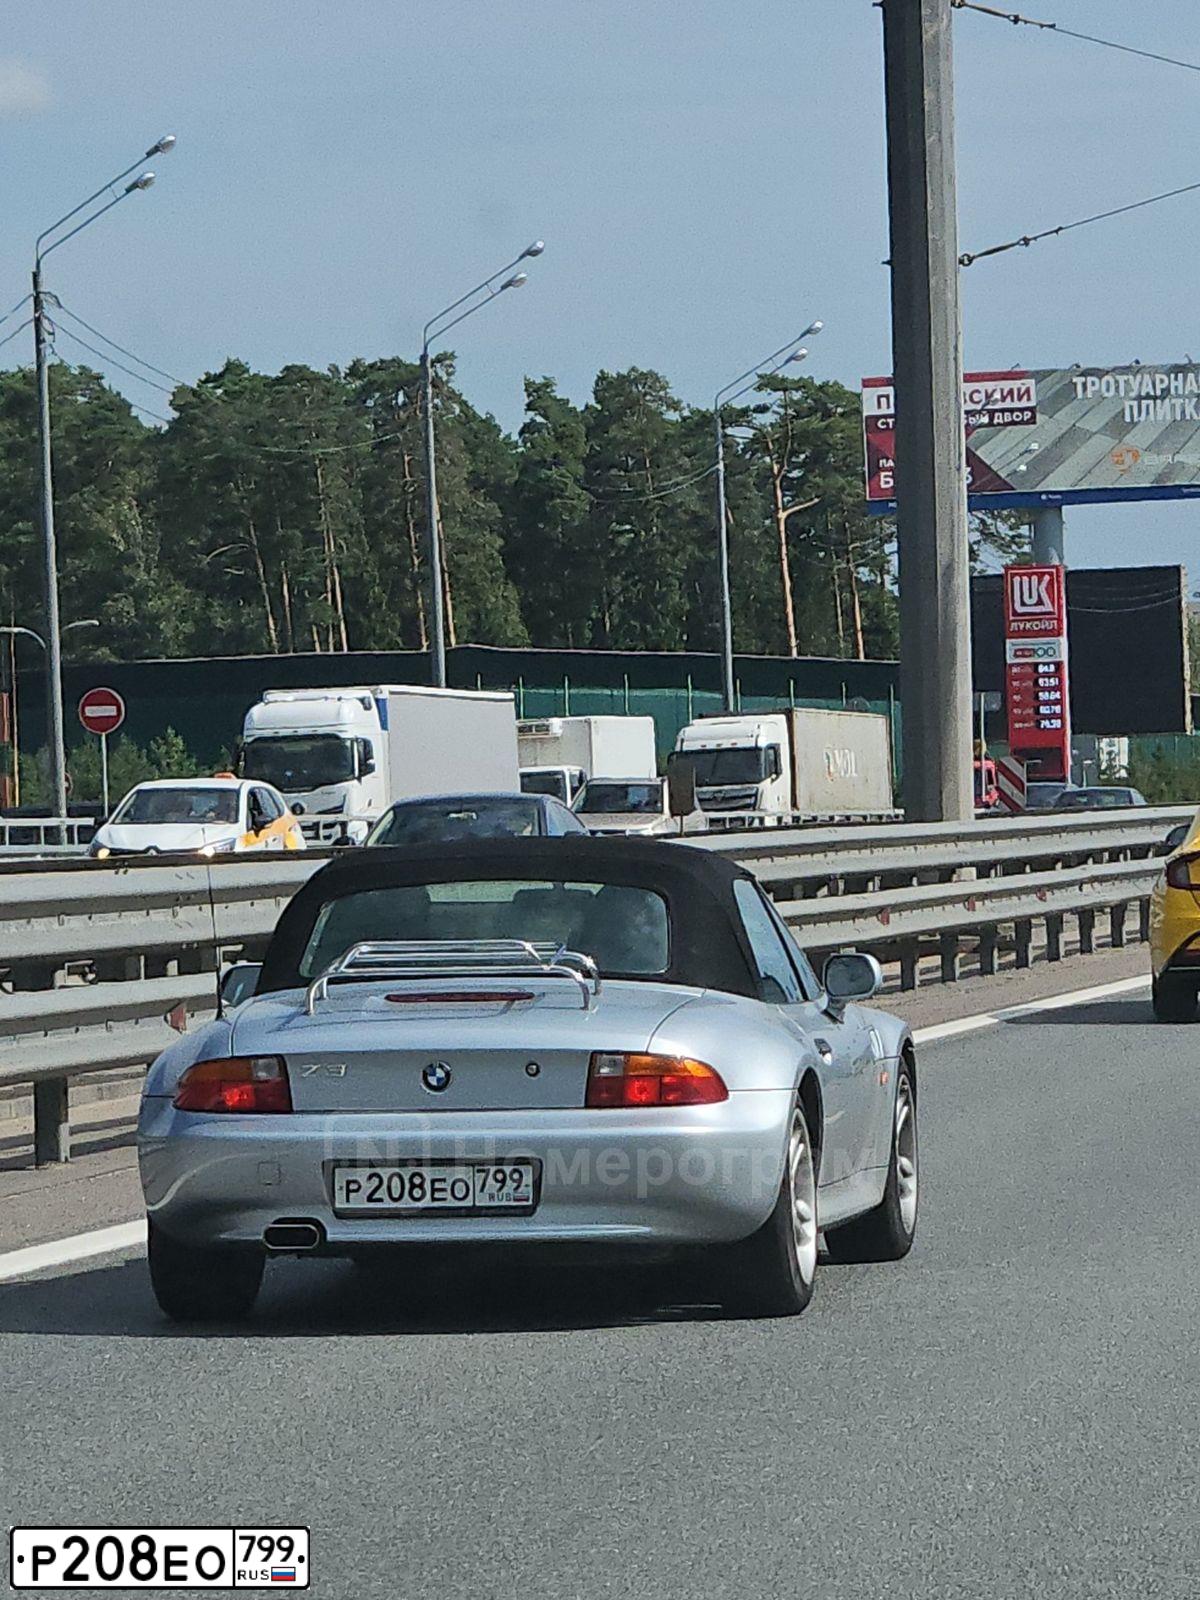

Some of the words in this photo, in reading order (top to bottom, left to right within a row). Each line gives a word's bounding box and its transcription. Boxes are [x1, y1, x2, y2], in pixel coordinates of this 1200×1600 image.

[1072, 372, 1200, 399] ТРОТУАРНА
[993, 411, 1032, 425] ДВОР
[1123, 398, 1200, 422] ПЛИТК
[344, 1172, 471, 1203] Р208ЕО
[476, 1167, 524, 1193] 799
